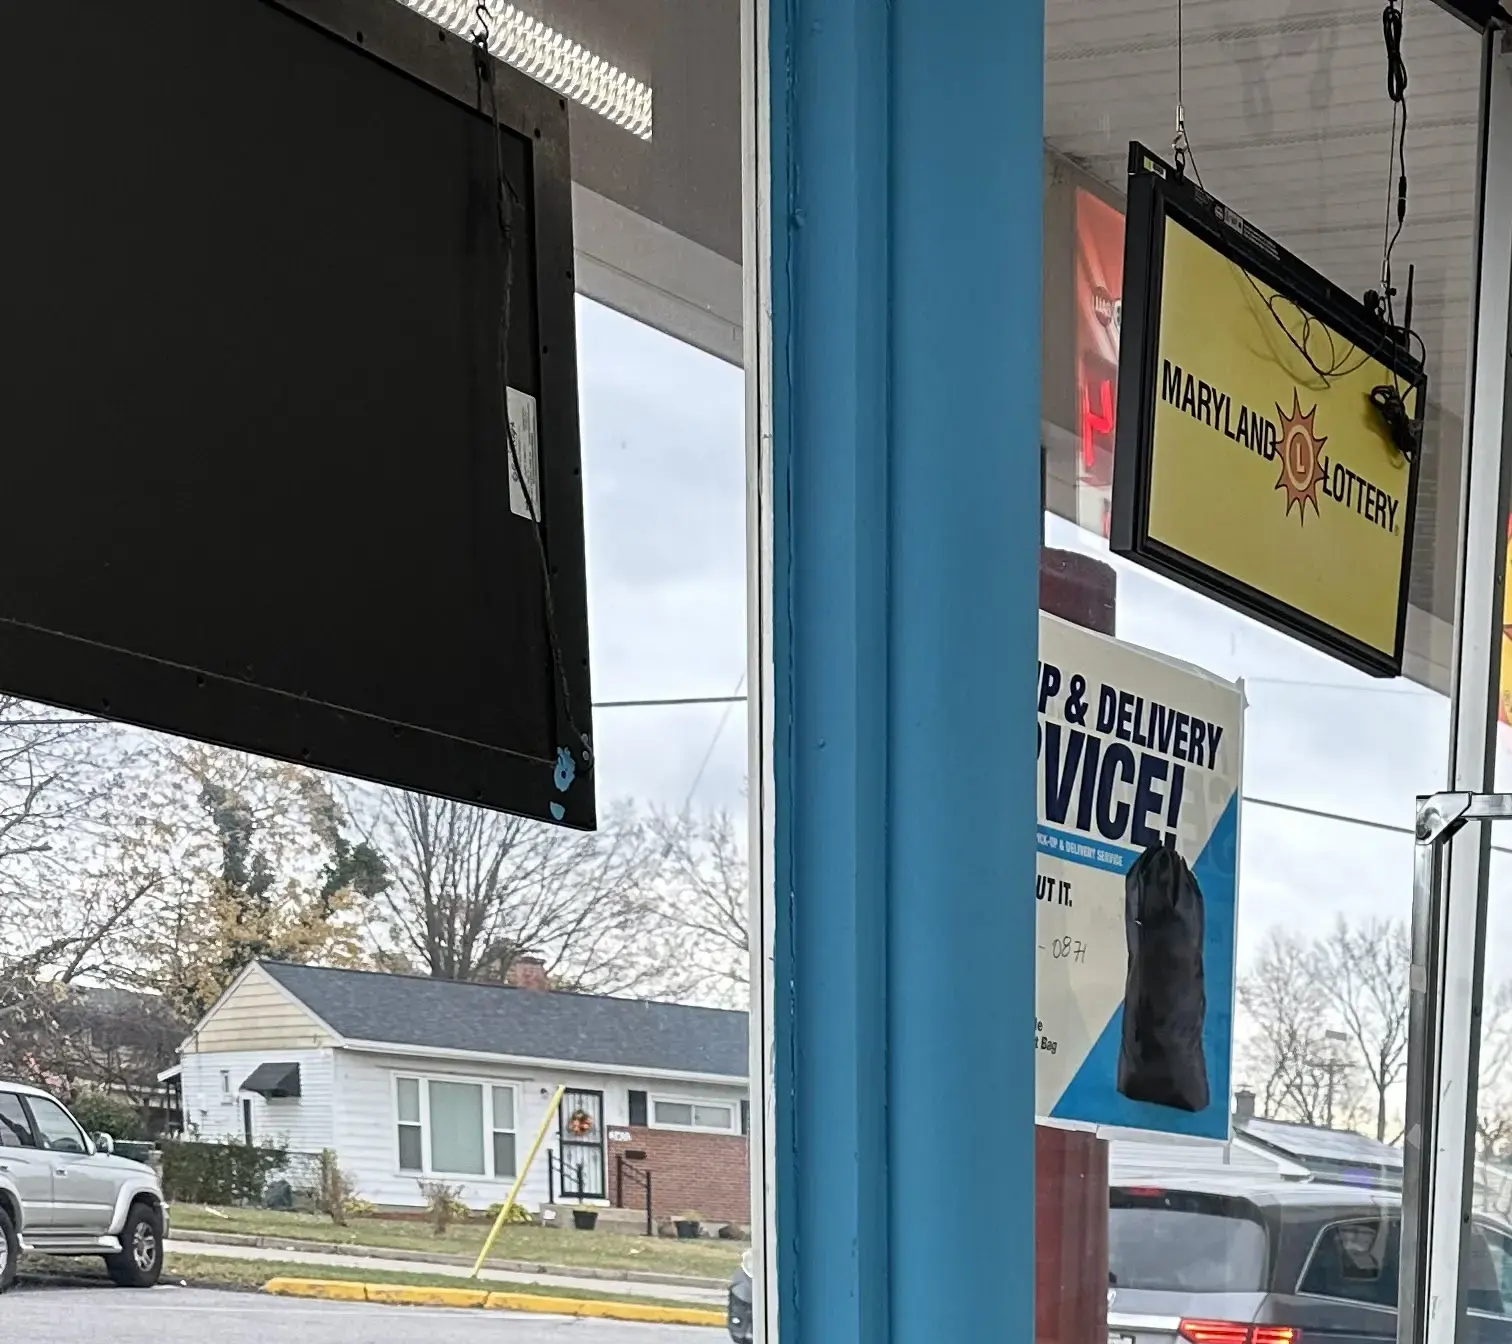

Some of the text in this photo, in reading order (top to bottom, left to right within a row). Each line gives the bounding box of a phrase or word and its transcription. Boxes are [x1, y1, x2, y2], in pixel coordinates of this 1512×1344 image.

[1162, 359, 1276, 462] MARYLAND
[1322, 456, 1399, 533] LOTTERY
[1038, 660, 1224, 771] P & DELIVERY
[1037, 720, 1186, 850] VICE!
[1059, 839, 1124, 867] & DELIVERY SERVICE
[1058, 880, 1073, 908] IT.
[1040, 1036, 1058, 1055] Bag
